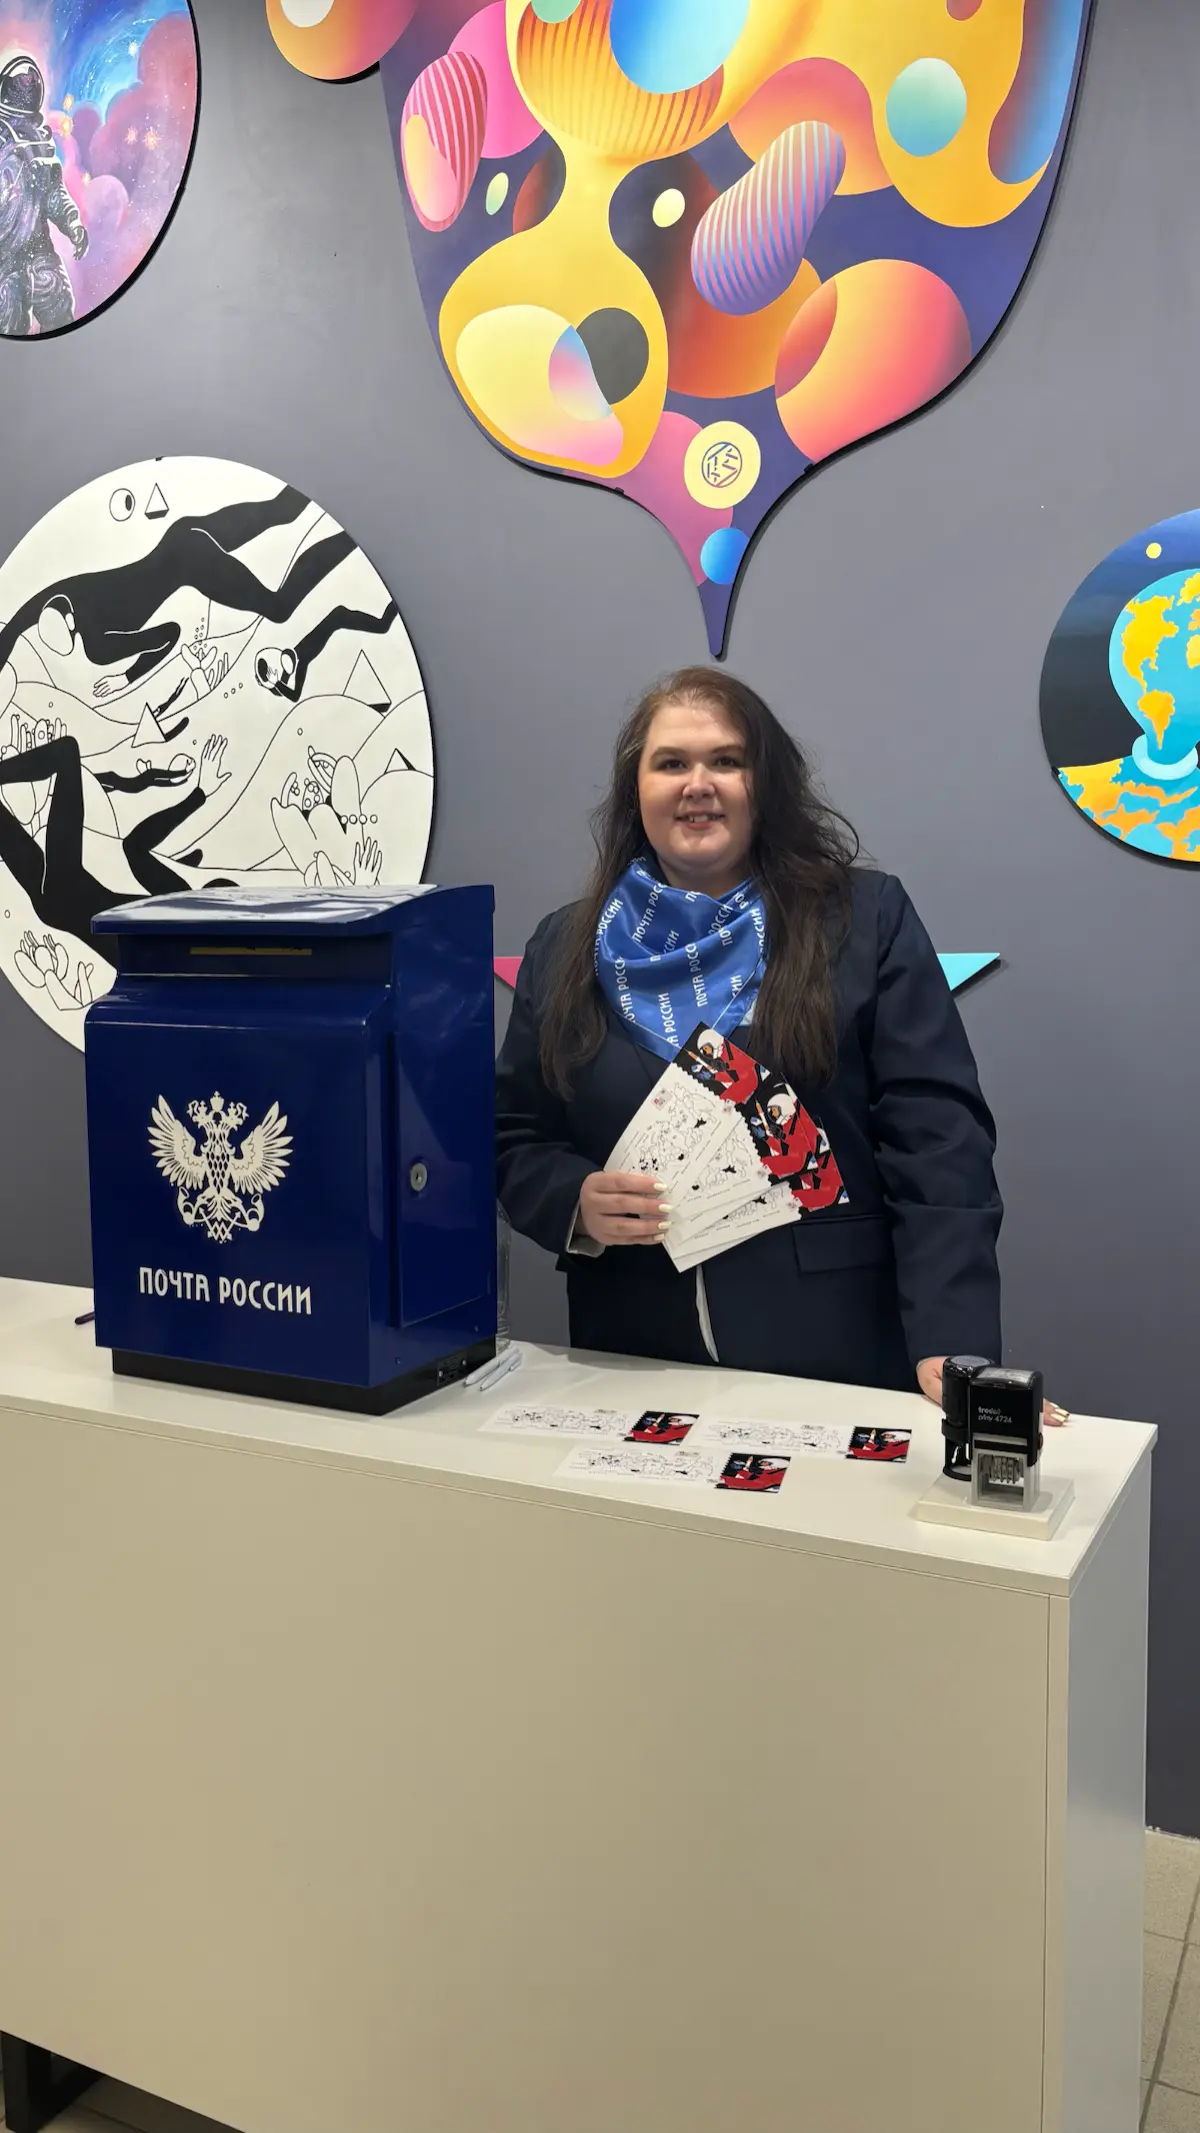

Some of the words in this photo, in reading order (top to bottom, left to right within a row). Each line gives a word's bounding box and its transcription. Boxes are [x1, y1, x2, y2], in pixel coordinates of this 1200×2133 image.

[596, 898, 624, 935] РОССИИ
[632, 908, 655, 943] ПОЧТА
[684, 942, 702, 973] РОСС
[620, 993, 636, 1023] ОЧТА
[692, 975, 709, 1008] ПОЧТА
[658, 992, 677, 1033] РОССИИ
[139, 1266, 211, 1302] ПОЧТА
[218, 1276, 312, 1315] РОССИИ
